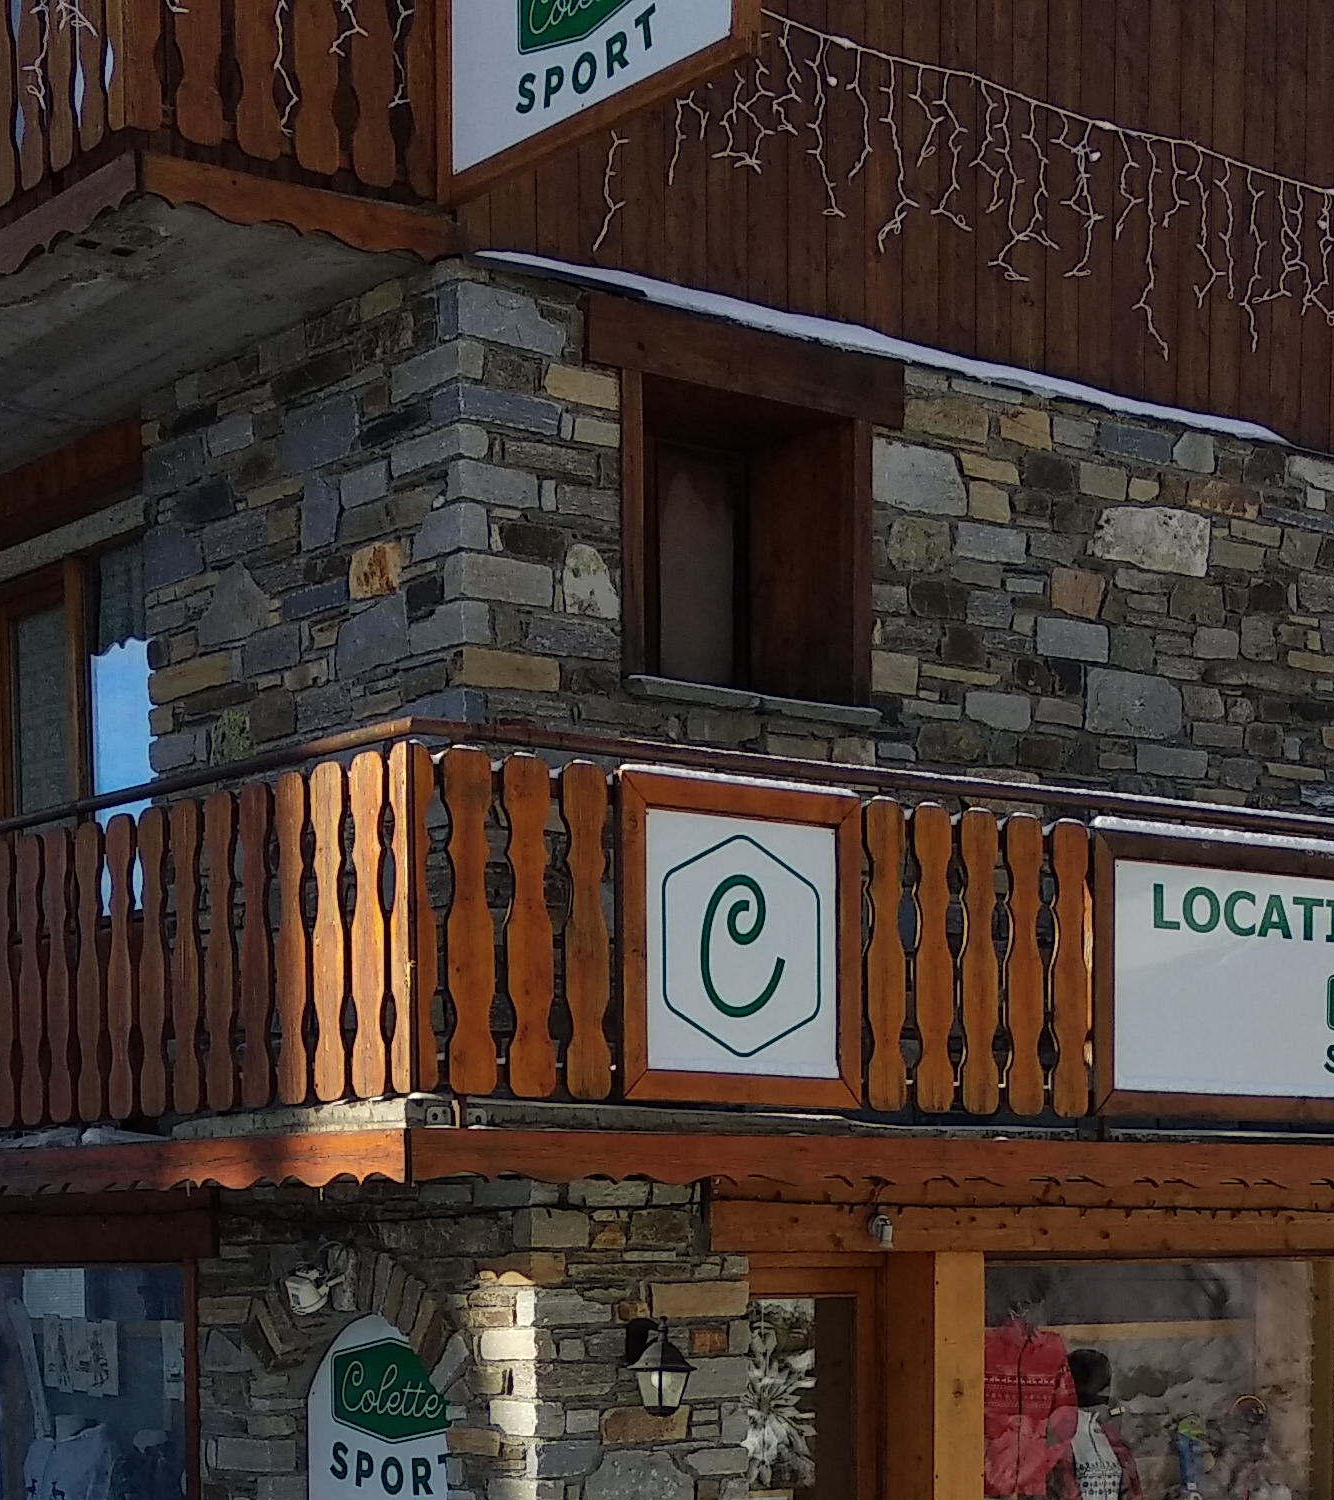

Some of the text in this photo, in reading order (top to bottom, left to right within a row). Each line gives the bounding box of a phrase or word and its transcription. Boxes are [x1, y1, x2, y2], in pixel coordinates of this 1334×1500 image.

[515, 2, 657, 114] SPORT
[700, 873, 786, 1018] C
[341, 1360, 444, 1420] Colette
